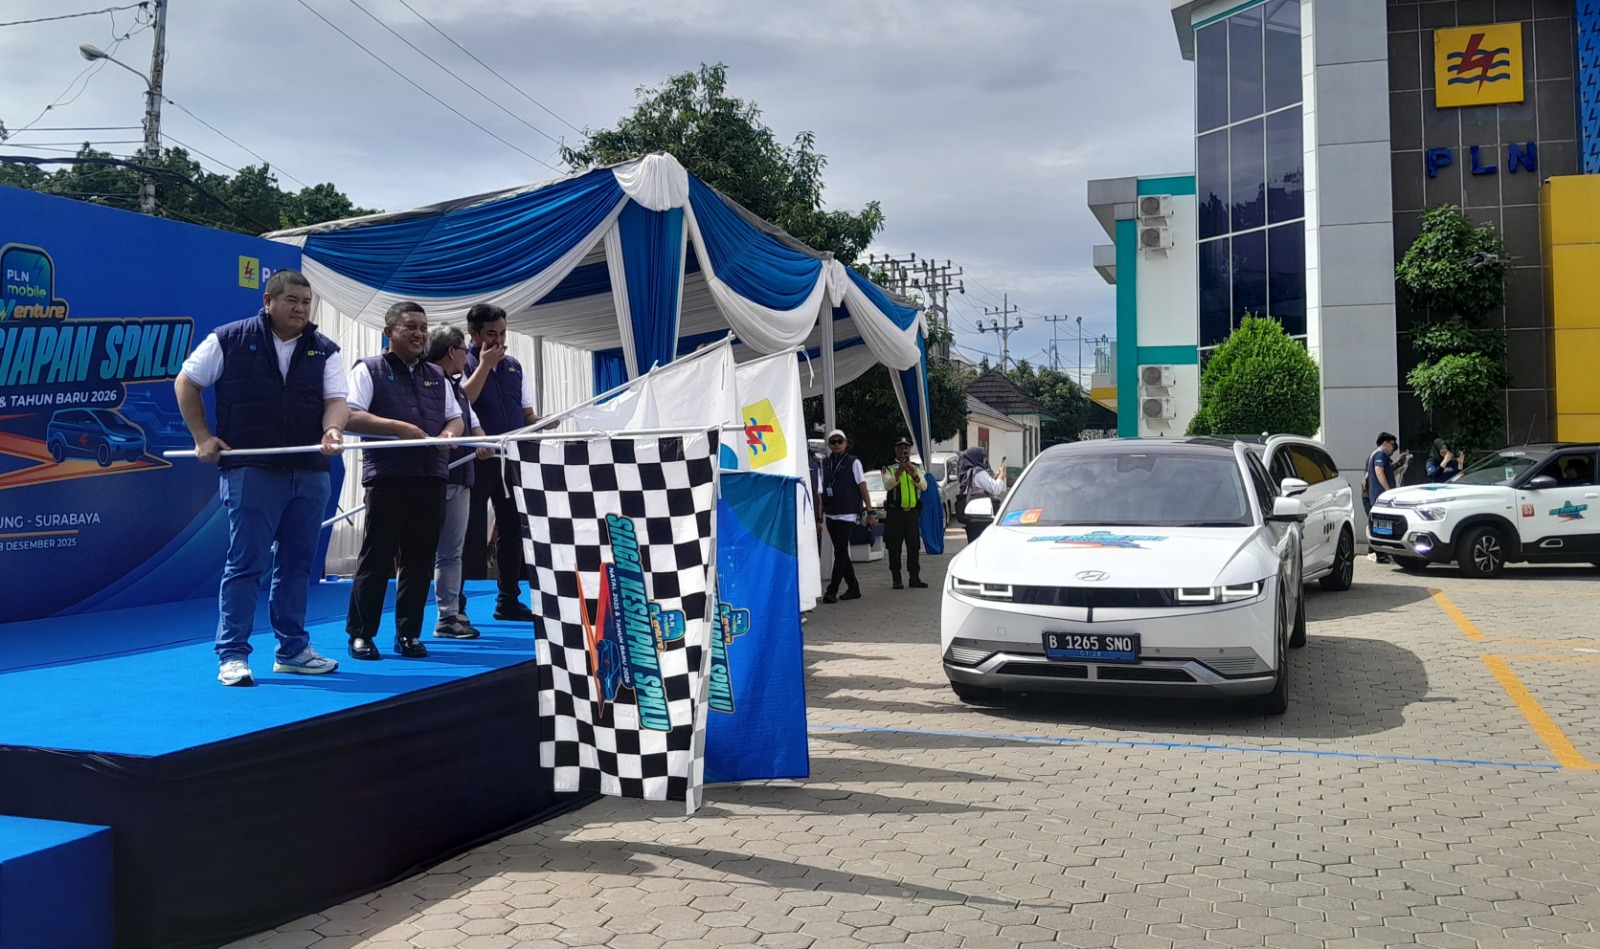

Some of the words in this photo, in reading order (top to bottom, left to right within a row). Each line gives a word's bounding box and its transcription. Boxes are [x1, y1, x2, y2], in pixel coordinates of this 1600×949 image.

[1427, 141, 1536, 178] PLN
[6, 268, 30, 283] PLN
[6, 284, 47, 299] mobile
[100, 323, 192, 380] SPKLU
[10, 393, 53, 408] TAHUN
[56, 391, 89, 406] BARU
[91, 389, 118, 402] 2026
[35, 512, 101, 528] SURABAYA
[6, 539, 55, 551] DESEMBER
[57, 537, 77, 548] 2025
[606, 513, 642, 574] SIAGA
[608, 566, 618, 591] NATAL
[612, 592, 621, 610] 2025
[618, 575, 659, 671] KESIAPAN
[668, 613, 676, 627] PLN
[615, 618, 624, 644] TAHUN
[1048, 634, 1058, 649] B
[1065, 635, 1099, 650] 1265
[620, 644, 628, 666] BARU
[622, 666, 631, 684] 2026
[633, 671, 670, 731] SPKLU
